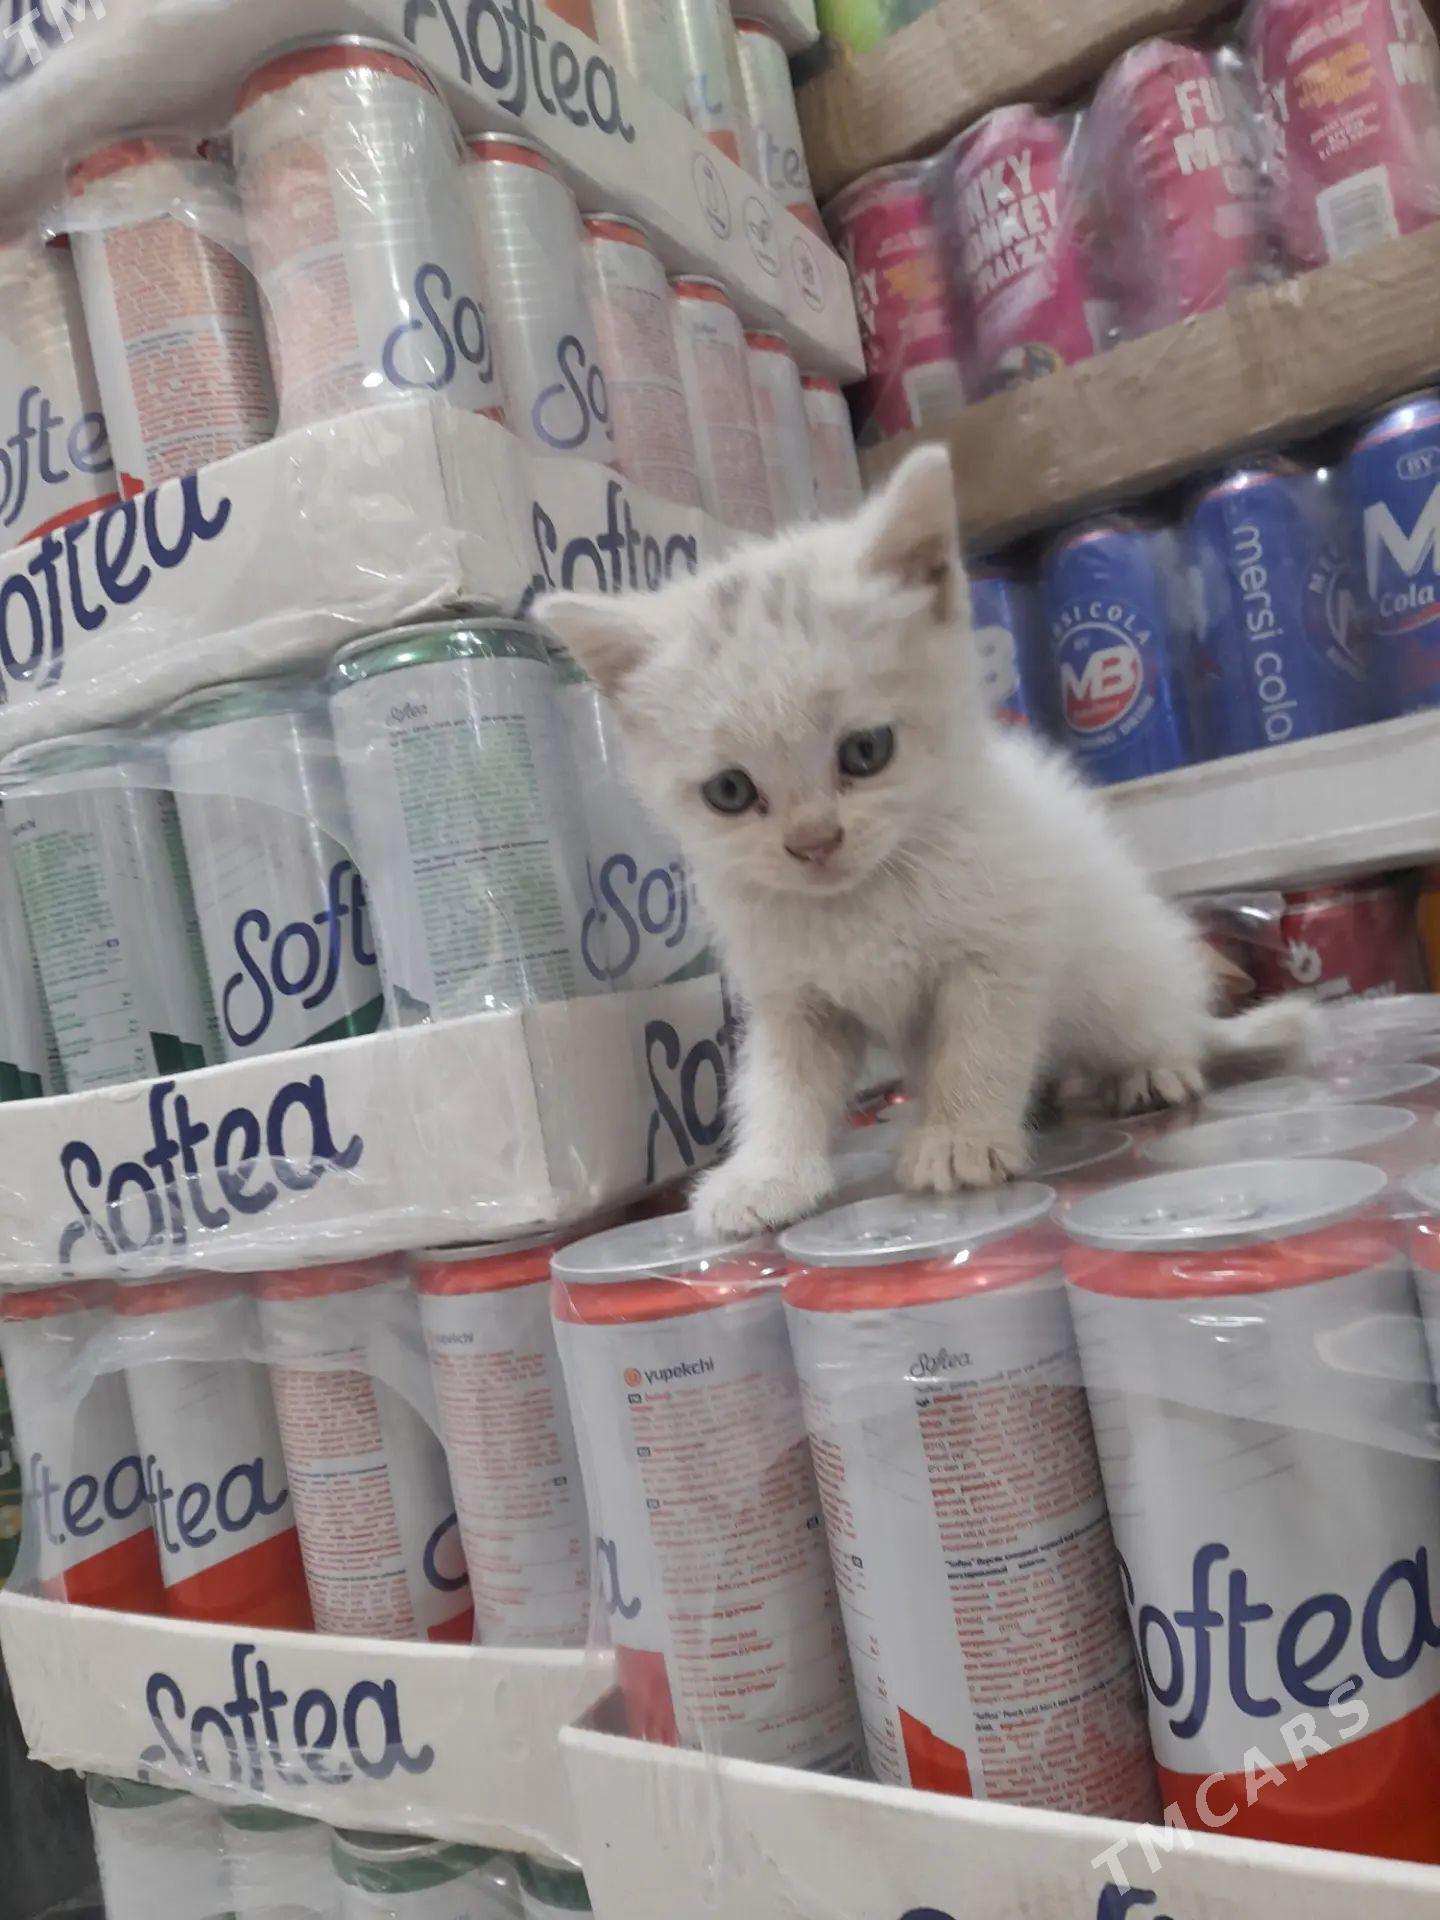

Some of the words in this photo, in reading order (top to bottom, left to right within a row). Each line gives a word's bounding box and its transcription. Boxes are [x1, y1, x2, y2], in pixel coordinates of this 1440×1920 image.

[531, 335, 614, 449] So
[0, 472, 231, 690] oftea
[1232, 524, 1284, 641] mersi
[1060, 645, 1138, 701] MB
[1254, 652, 1298, 742] cola
[59, 1074, 363, 1277] Softea
[644, 1356, 715, 1385] yupekchi
[1117, 1542, 1440, 1740] oftea
[137, 1644, 435, 1792] Softea
